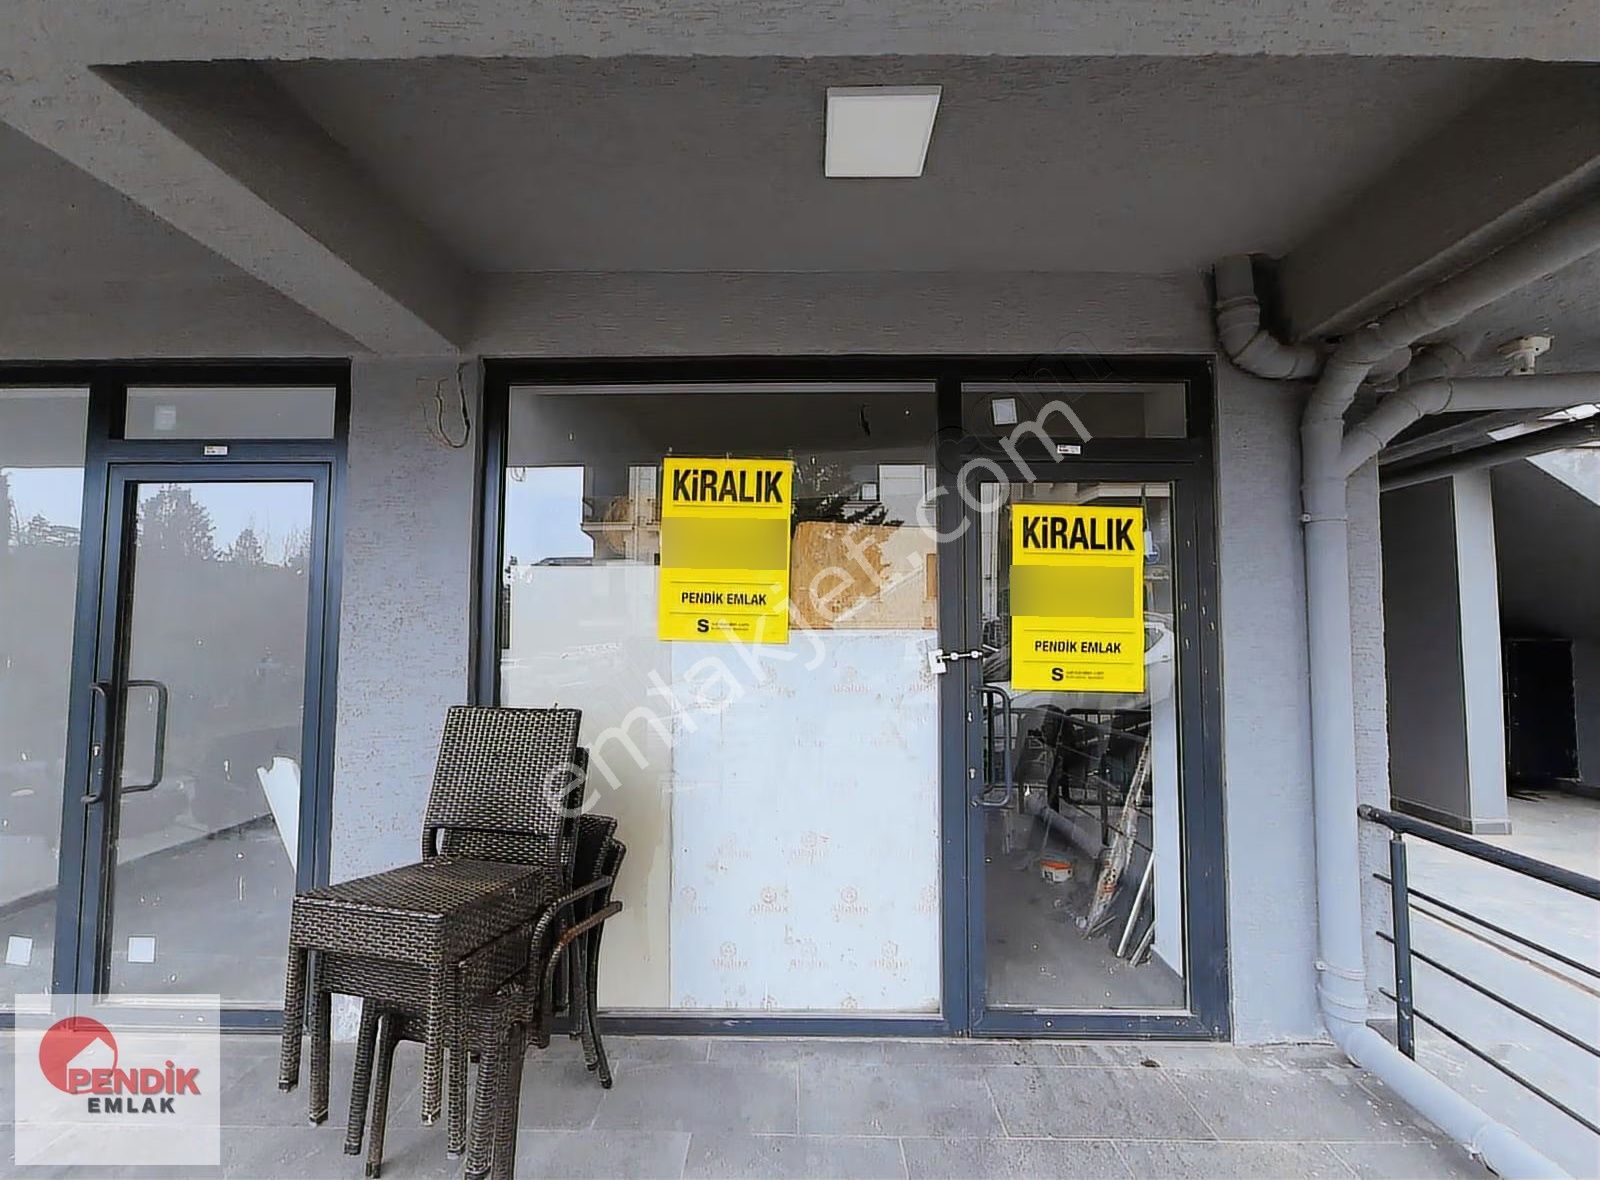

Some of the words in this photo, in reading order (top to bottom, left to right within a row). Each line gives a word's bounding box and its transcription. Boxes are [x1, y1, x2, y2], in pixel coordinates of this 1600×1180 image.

[681, 590, 724, 605] PENDİK
[726, 592, 767, 606] EMLAK
[697, 618, 710, 633] S
[1034, 640, 1077, 653] PENDİK
[1080, 641, 1122, 654] EMLAK
[1051, 667, 1064, 682] S
